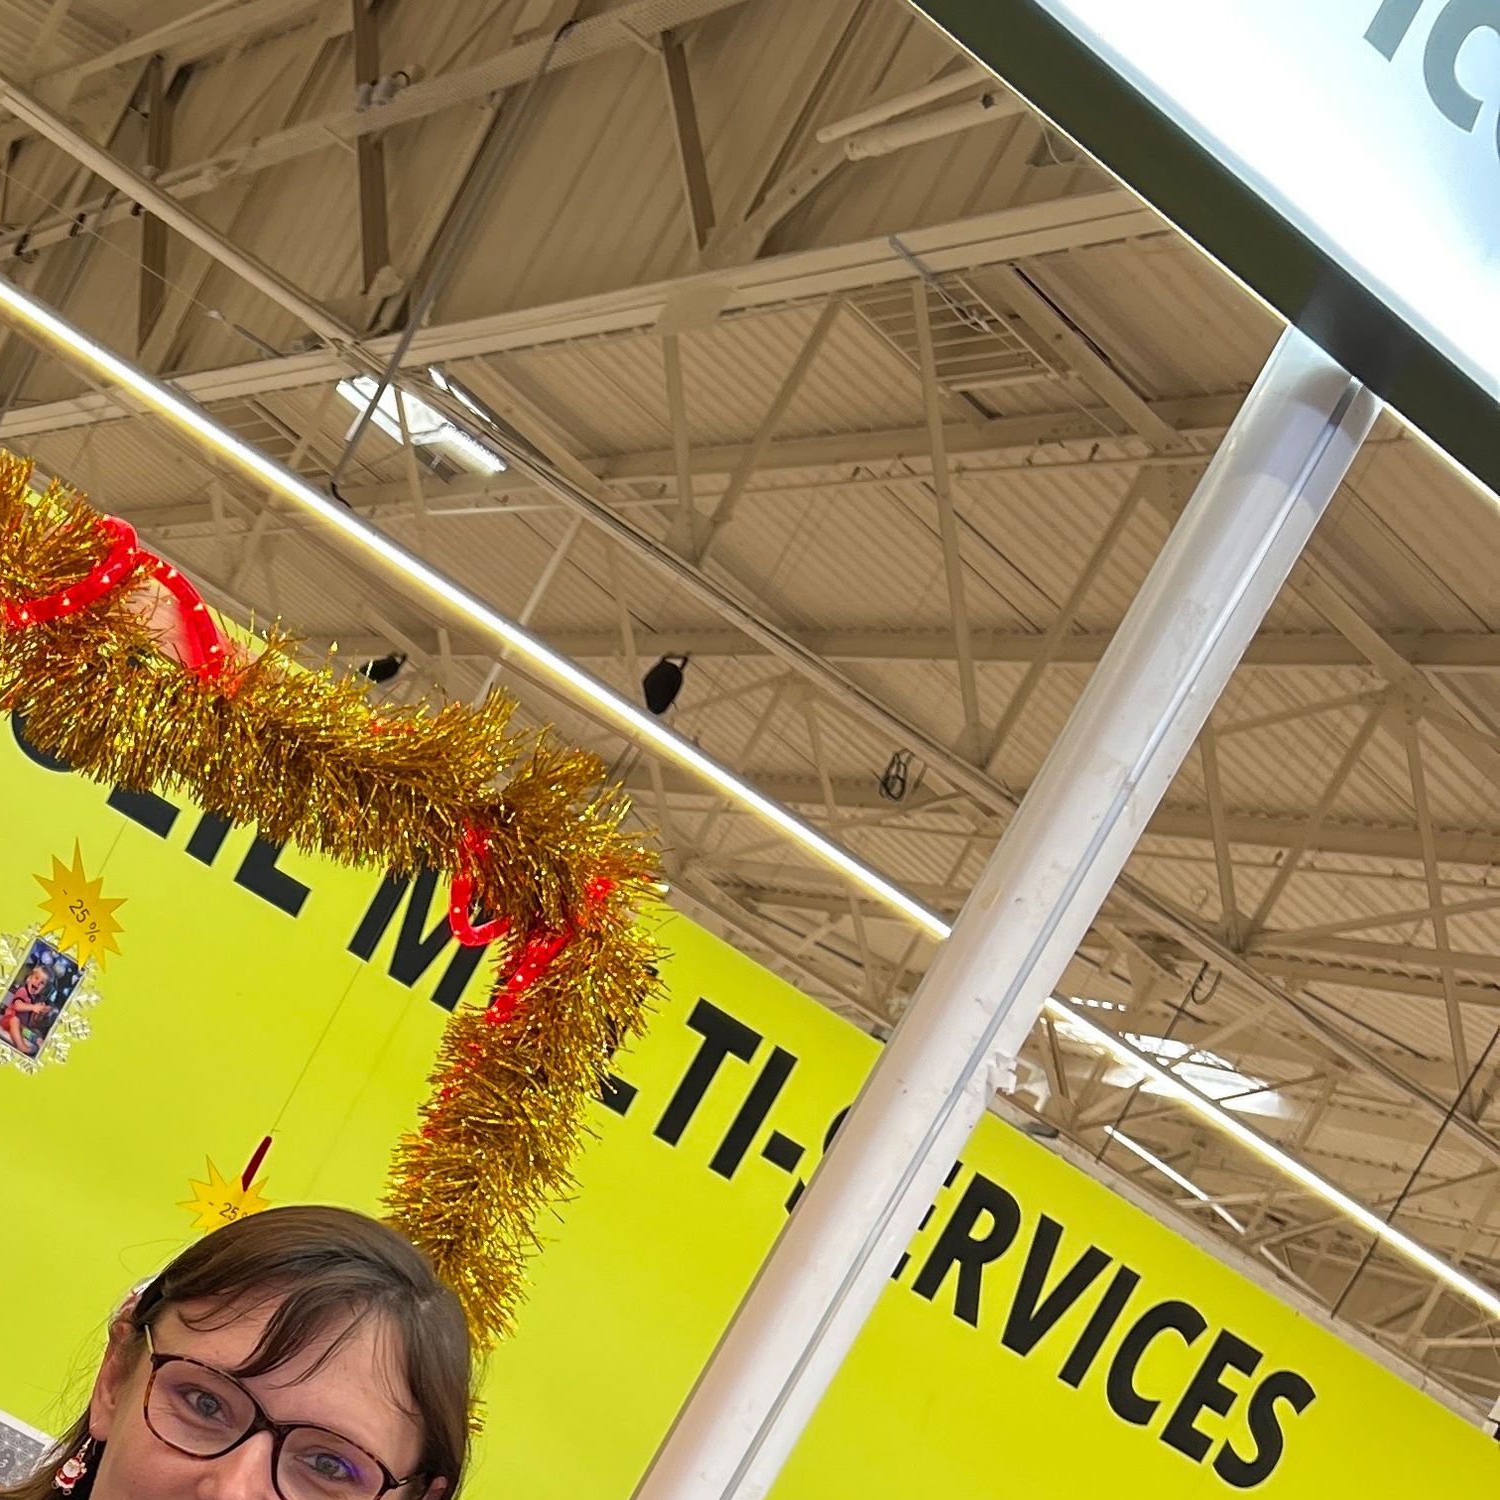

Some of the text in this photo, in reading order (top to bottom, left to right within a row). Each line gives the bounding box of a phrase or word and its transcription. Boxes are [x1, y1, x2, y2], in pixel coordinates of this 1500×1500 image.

[69, 899, 90, 923] 25
[84, 922, 100, 943] %
[219, 1202, 239, 1221] 25
